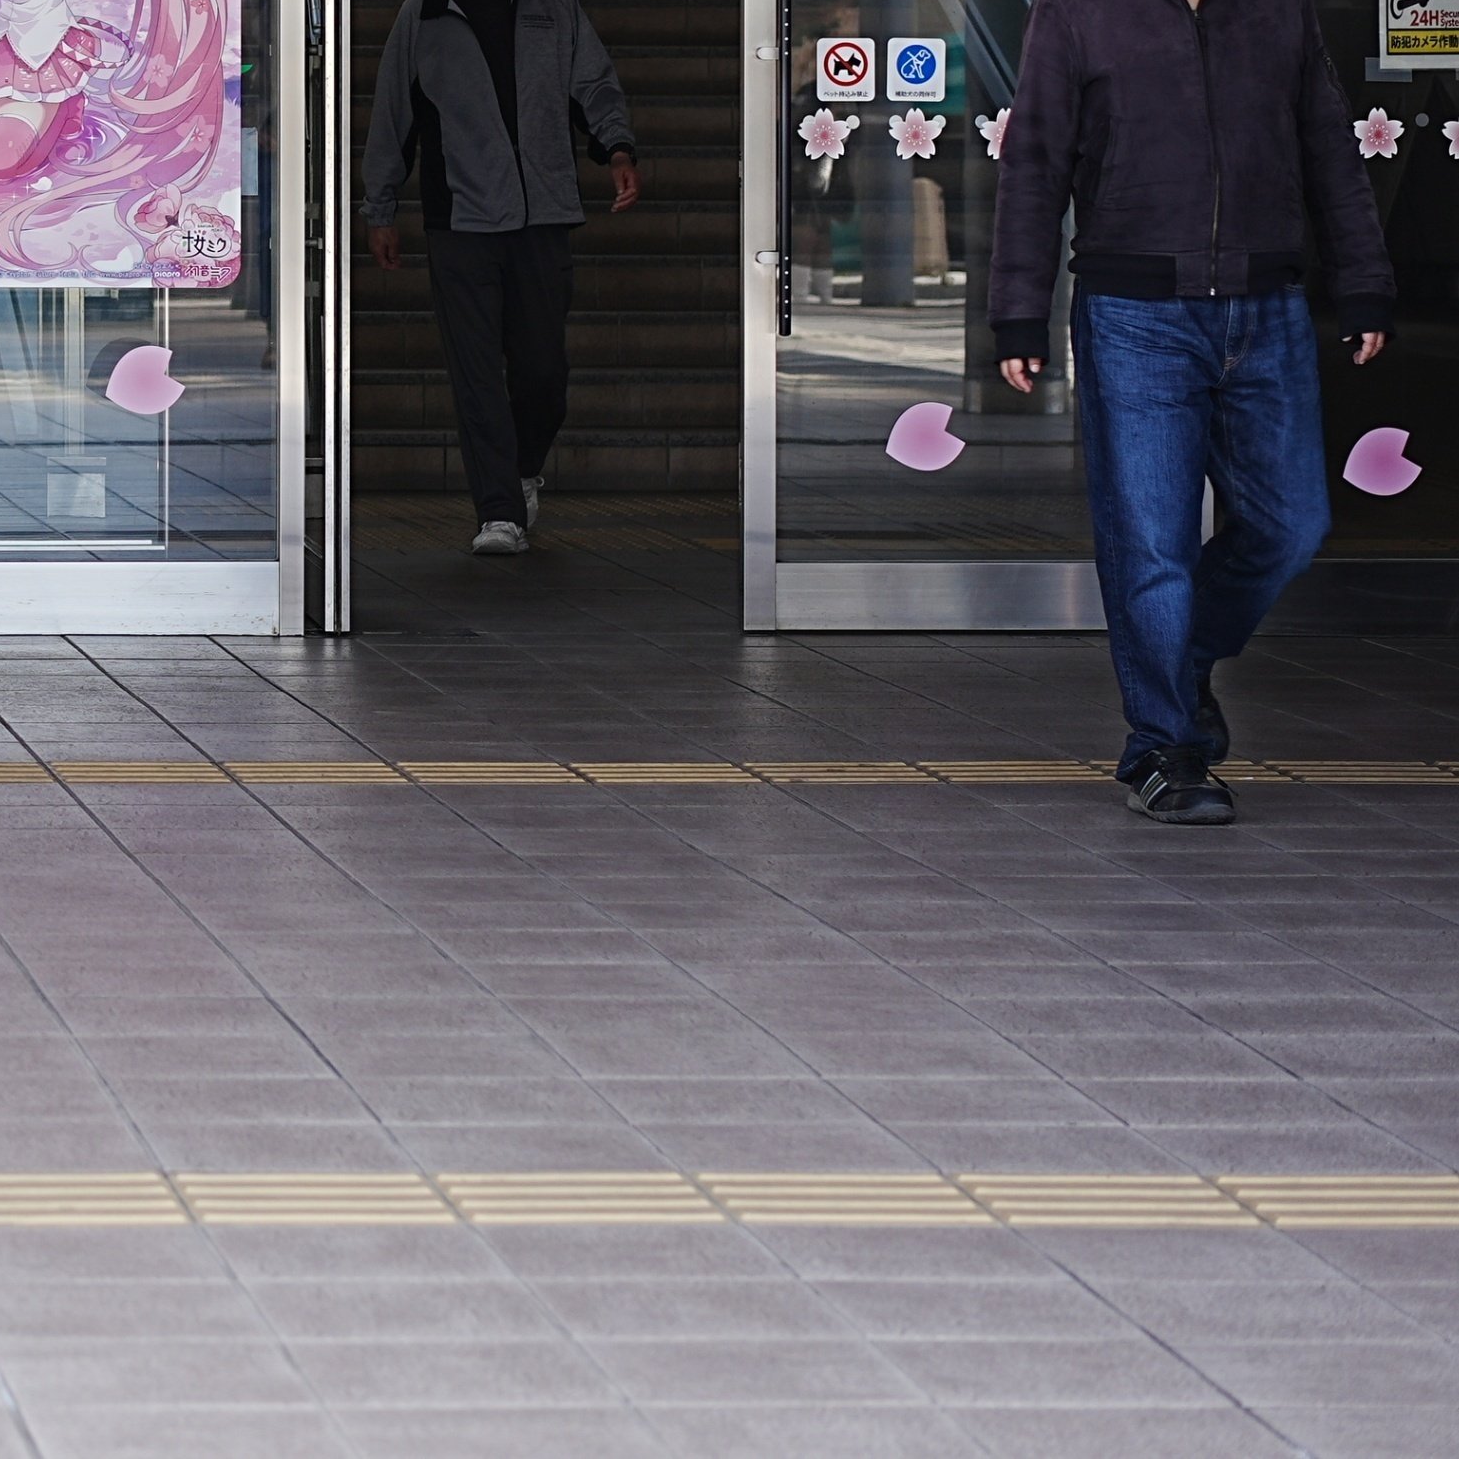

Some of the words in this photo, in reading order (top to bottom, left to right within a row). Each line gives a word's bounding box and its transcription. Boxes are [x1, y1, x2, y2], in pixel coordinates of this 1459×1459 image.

[1410, 9, 1439, 27] 24H
[1391, 35, 1459, 49] 防犯カメラ作動
[181, 229, 227, 255] 桜ミク
[185, 265, 232, 283] 初音ミク
